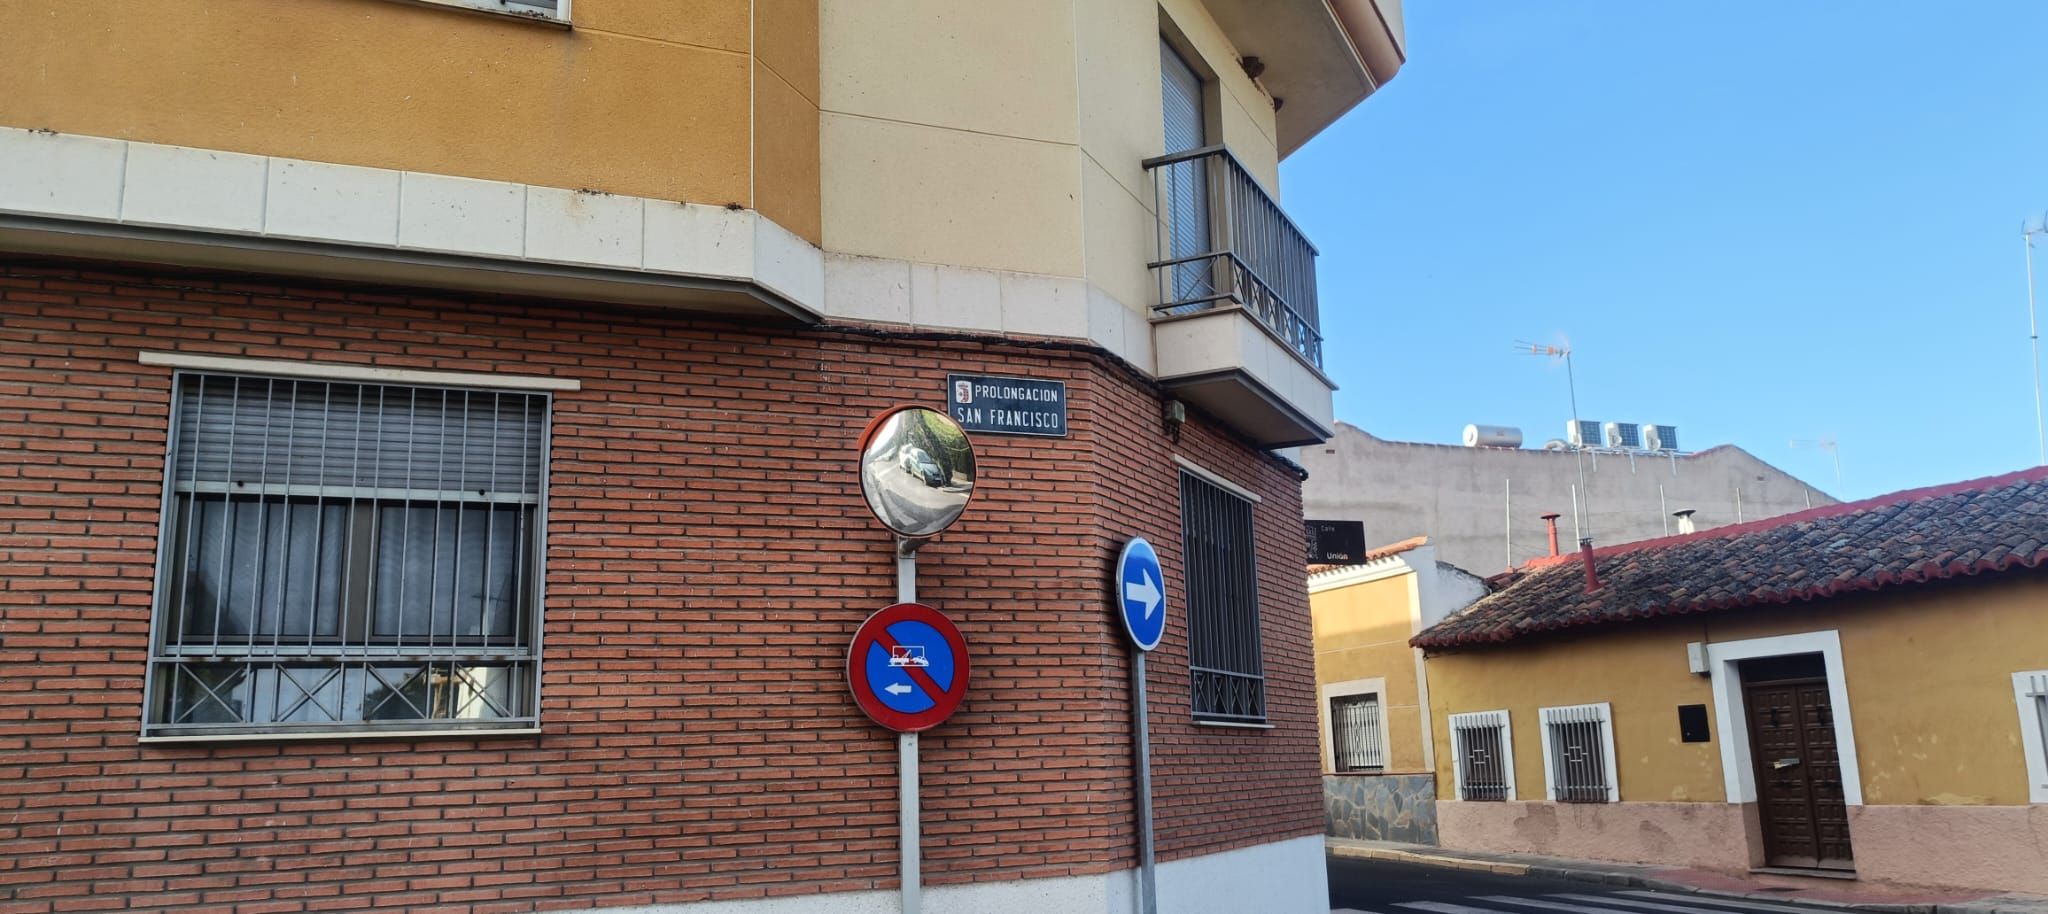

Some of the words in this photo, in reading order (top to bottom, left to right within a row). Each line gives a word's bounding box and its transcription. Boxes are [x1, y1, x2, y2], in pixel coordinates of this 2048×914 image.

[975, 385, 1058, 402] PROLONGACION
[957, 407, 982, 424] SAN
[990, 409, 1059, 429] FRANCISCO
